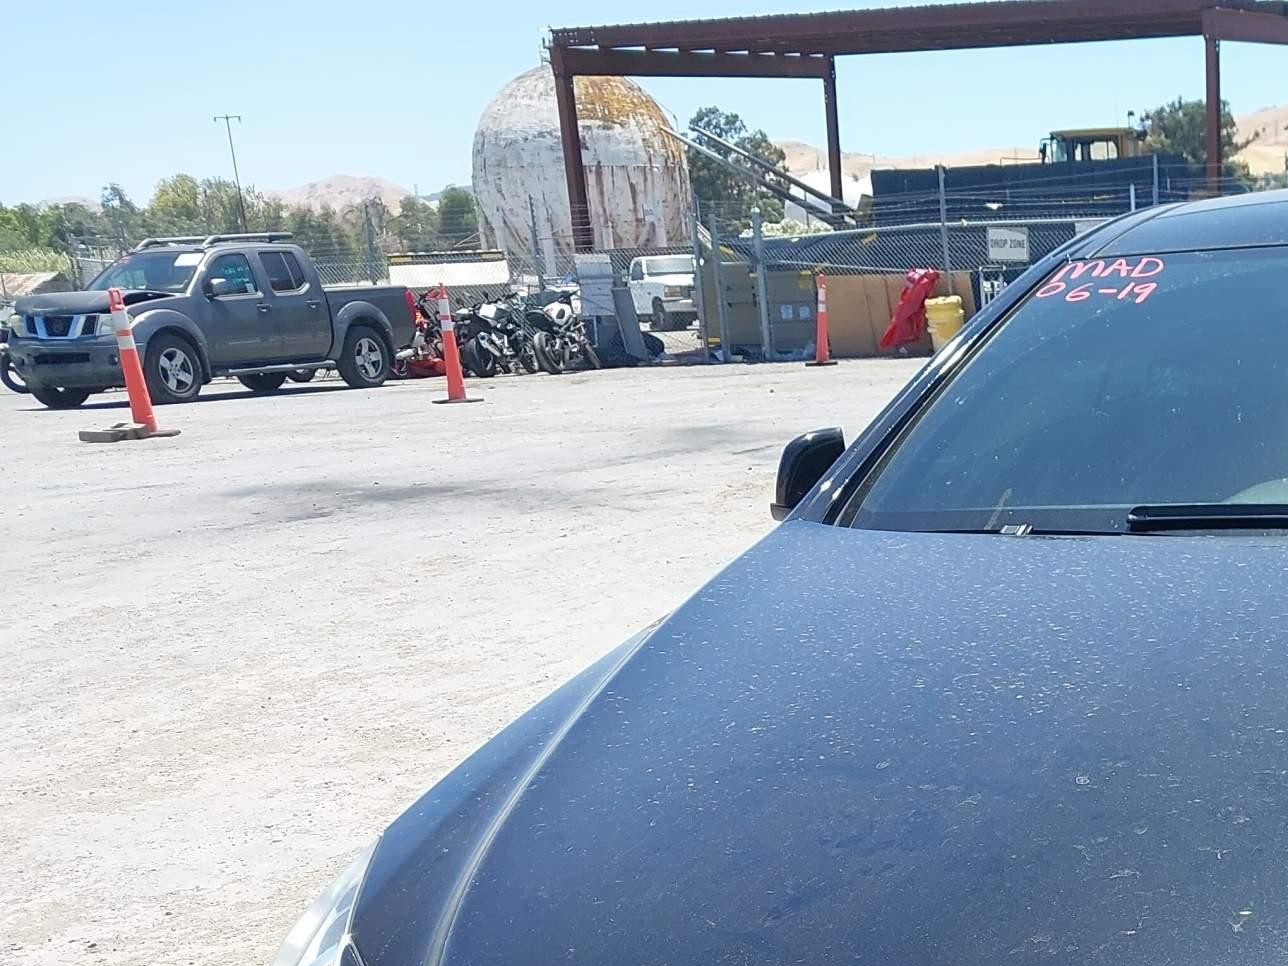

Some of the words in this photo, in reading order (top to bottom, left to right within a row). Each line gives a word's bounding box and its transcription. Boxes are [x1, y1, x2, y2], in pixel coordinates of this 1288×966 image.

[990, 238, 1008, 249] DROP
[1009, 238, 1026, 249] ZONE
[1049, 257, 1165, 283] MAD
[1035, 281, 1158, 304] 06-19
